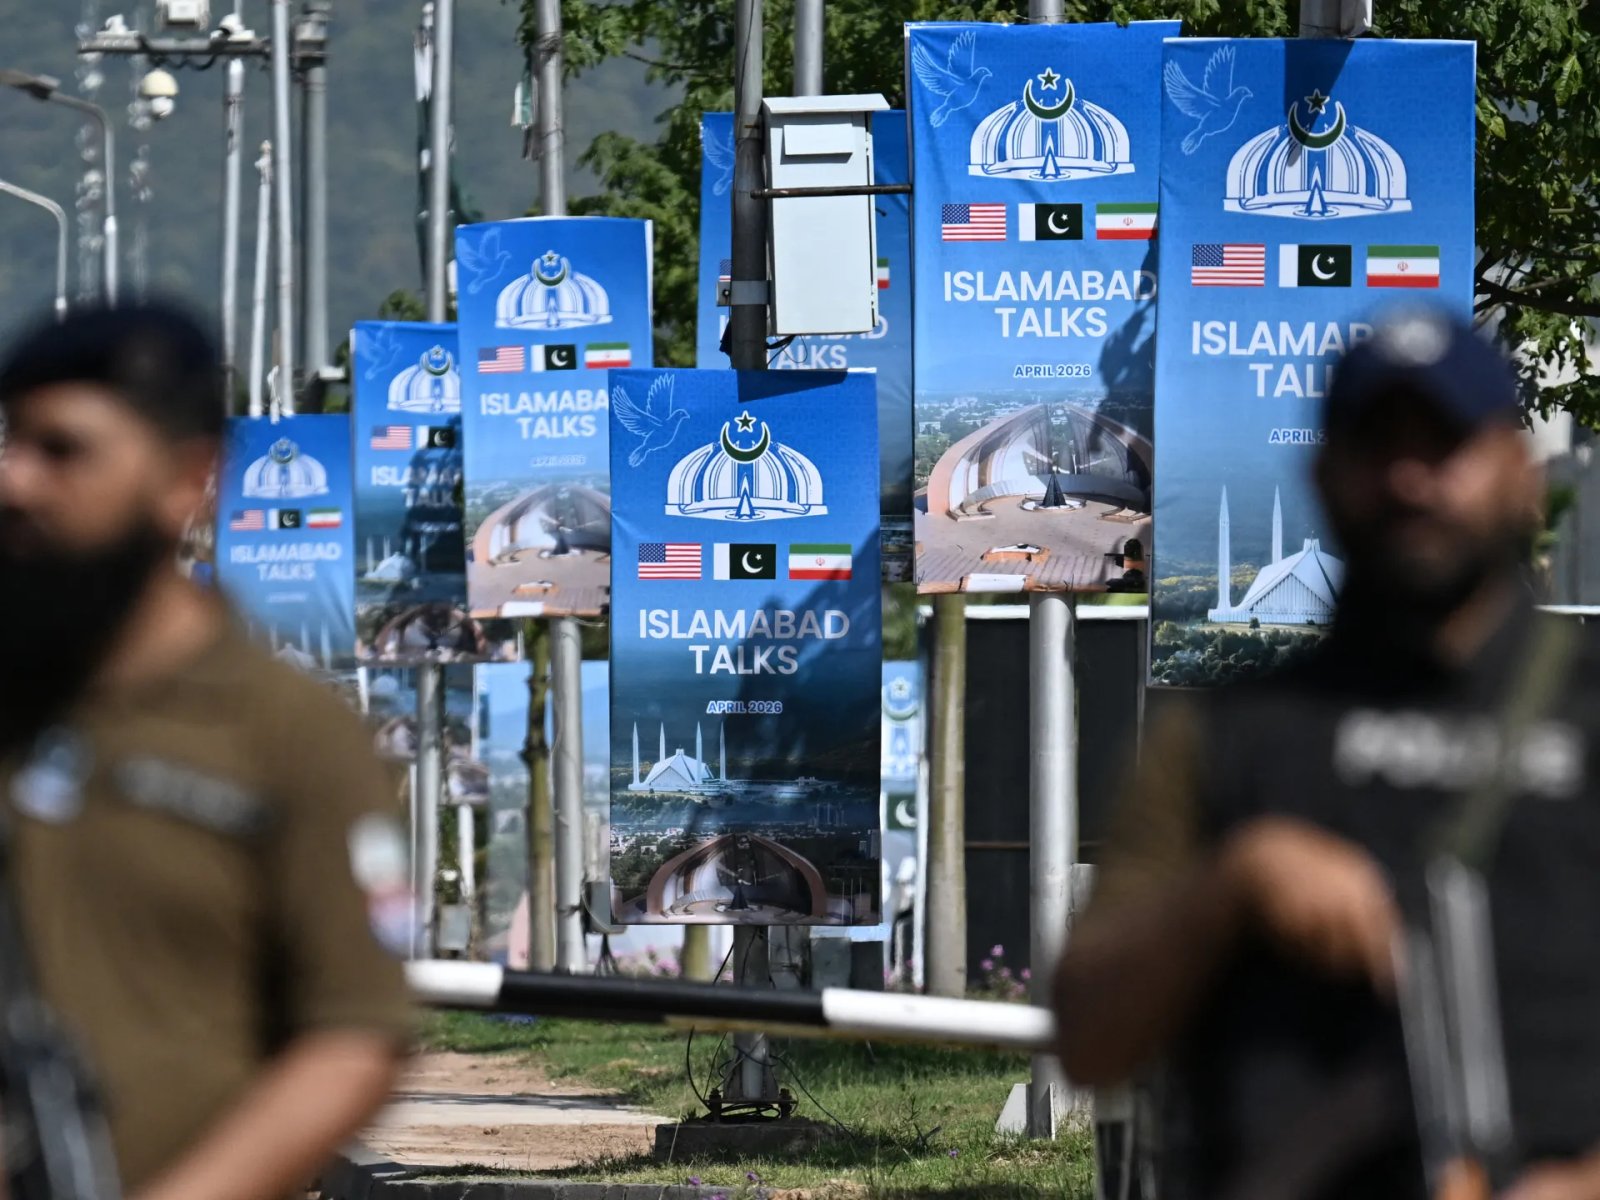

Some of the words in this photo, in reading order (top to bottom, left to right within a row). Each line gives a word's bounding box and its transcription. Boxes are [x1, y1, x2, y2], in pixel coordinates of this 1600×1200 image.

[944, 270, 1157, 302] ISLAMABAD
[994, 307, 1108, 338] TALKS
[766, 344, 848, 369] ALKS
[1013, 364, 1054, 378] APRIL
[1055, 364, 1092, 378] 2026
[1249, 363, 1334, 398] TAL
[480, 389, 609, 415] ISLAMABA
[516, 414, 597, 439] TALKS
[1268, 427, 1315, 445] APRIL
[400, 488, 456, 508] TALK
[230, 542, 342, 563] ISLAMABAD
[256, 562, 316, 581] TALKS
[638, 608, 850, 640] ISLAMABAD
[688, 645, 799, 675] TALKS
[706, 700, 746, 714] APRIL
[747, 700, 783, 714] 2026
